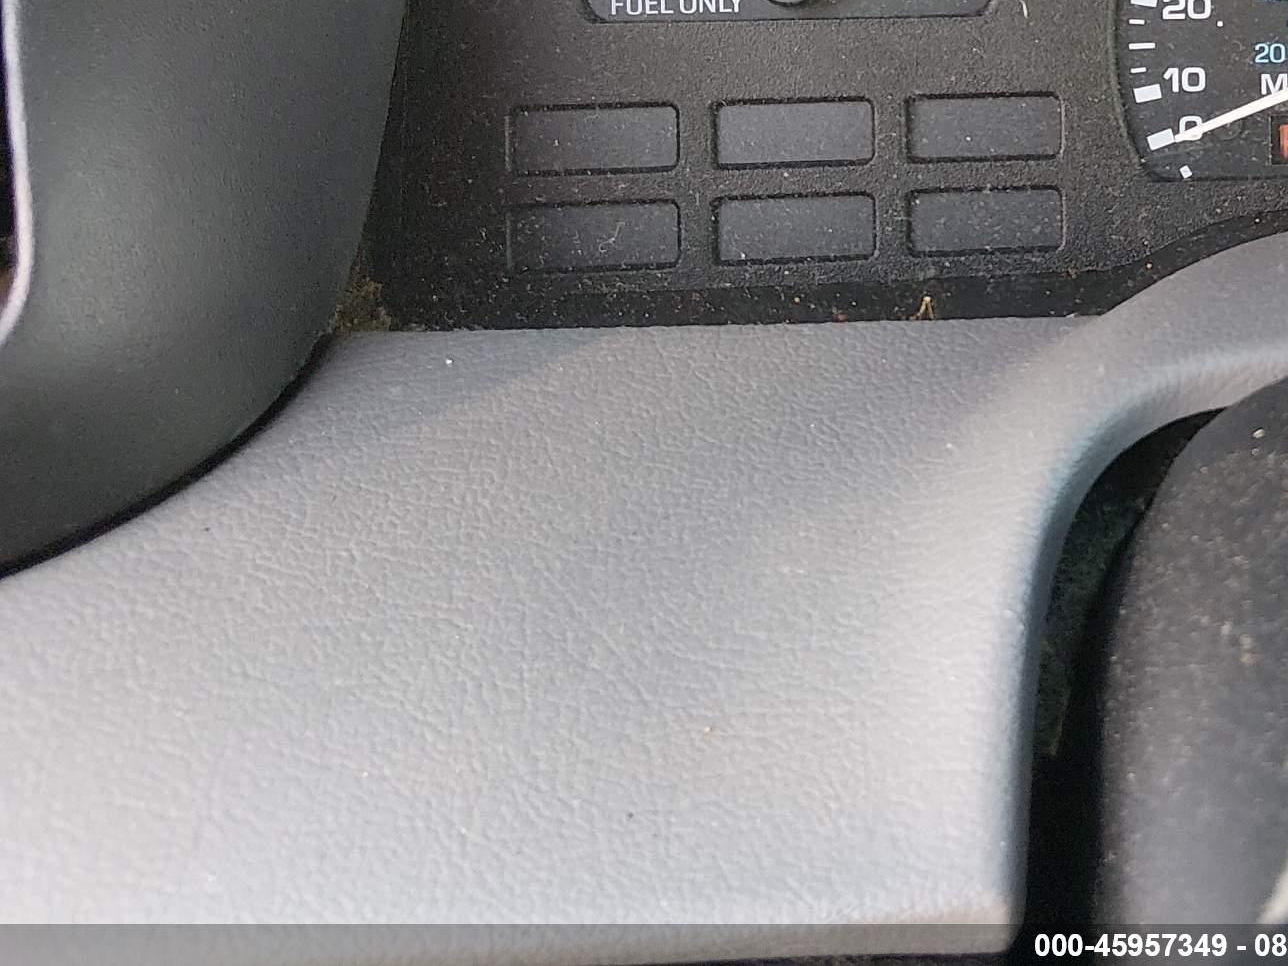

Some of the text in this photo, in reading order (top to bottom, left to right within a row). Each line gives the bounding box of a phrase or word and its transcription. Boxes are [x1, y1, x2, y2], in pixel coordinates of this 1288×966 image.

[1254, 43, 1286, 63] 20
[1163, 67, 1206, 93] 10
[1178, 115, 1203, 141] 0
